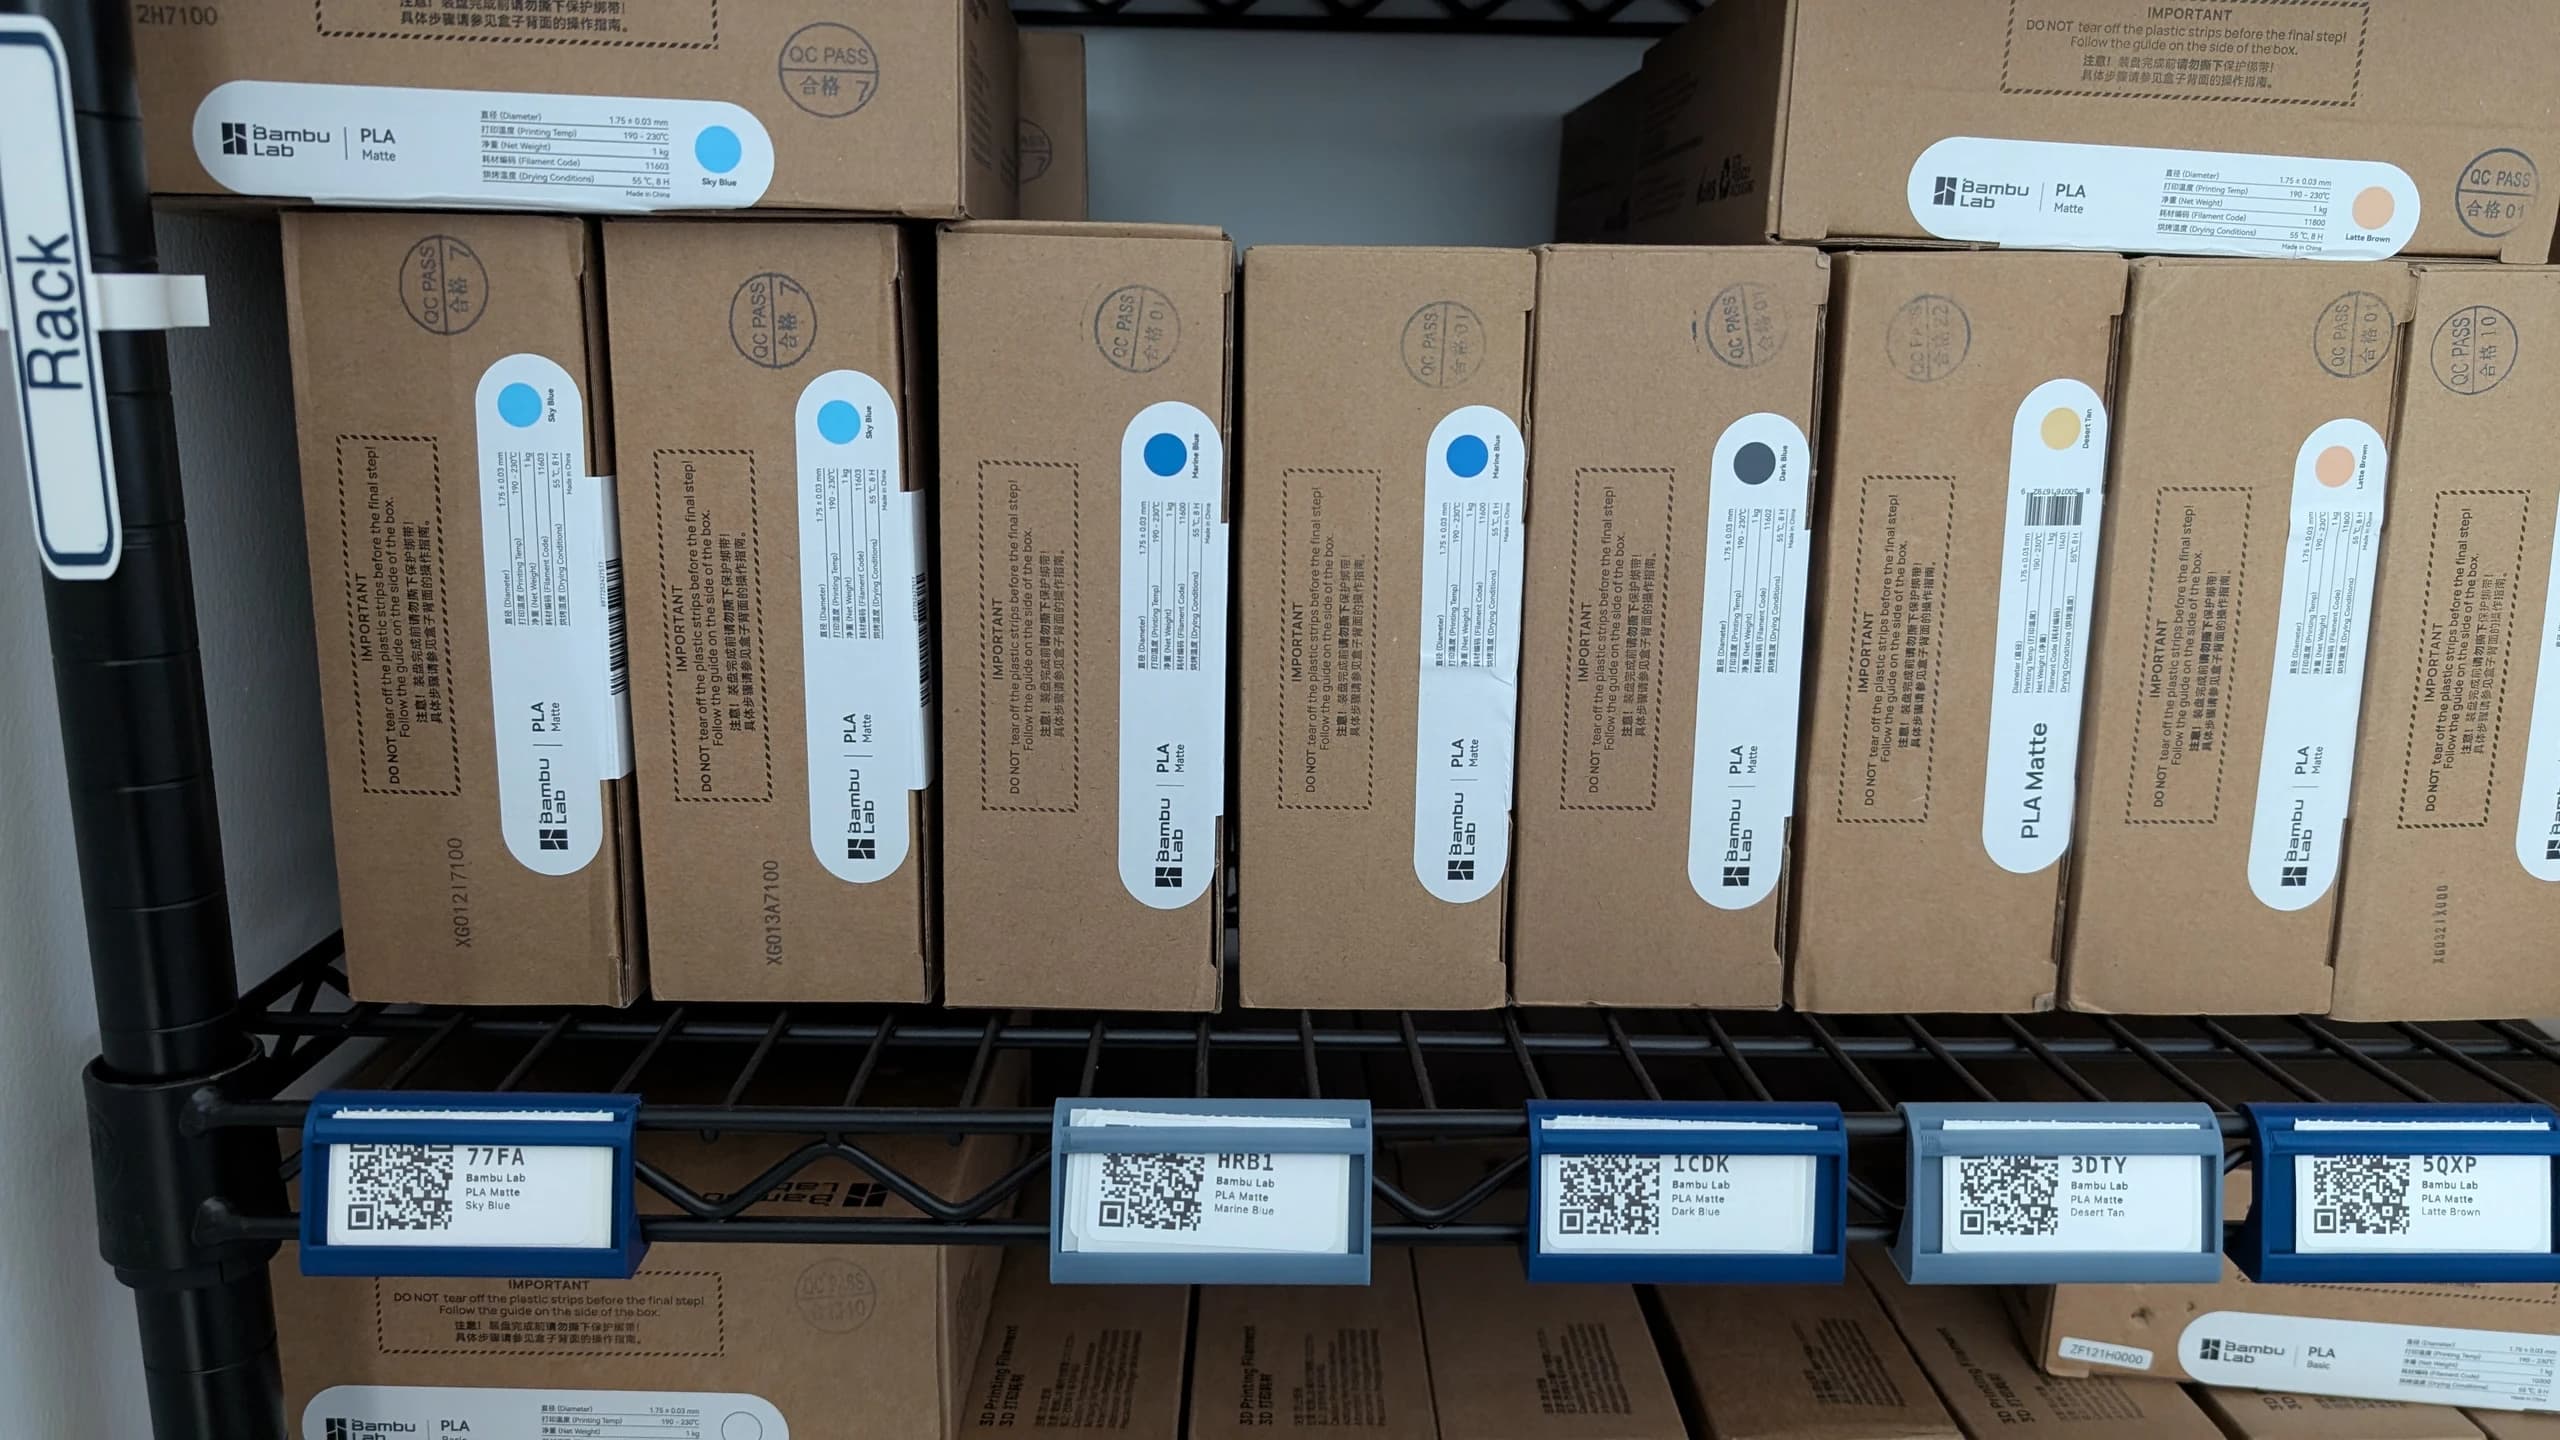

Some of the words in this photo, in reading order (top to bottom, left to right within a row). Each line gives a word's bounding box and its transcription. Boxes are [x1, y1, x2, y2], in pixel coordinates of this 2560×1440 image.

[2147, 6, 2232, 21] IMPORTANT
[788, 46, 818, 63] QC
[823, 46, 870, 65] PASS
[799, 75, 840, 96] 合格
[855, 80, 875, 104] 7
[252, 123, 330, 143] Bambu
[360, 127, 396, 144] PLA
[253, 142, 294, 157] Lab
[362, 149, 396, 162] Matte
[701, 177, 717, 188] Sky
[718, 178, 737, 186] Blue
[1961, 178, 2029, 196] Bambu
[2055, 183, 2086, 198] PLA
[1959, 194, 1995, 208] Lab
[2053, 202, 2084, 214] Matte
[2345, 233, 2365, 241] Latte
[2366, 234, 2390, 243] Brown
[449, 244, 470, 261] 7
[418, 245, 437, 291] PASS
[445, 277, 469, 315] 合格
[16, 234, 84, 389] Rack
[420, 297, 439, 326] QC
[2451, 317, 2470, 357] PASS
[2480, 316, 2496, 336] 10
[2478, 345, 2496, 377] 合格
[2450, 363, 2469, 386] QC
[546, 387, 555, 405] Blue
[547, 407, 557, 422] Sky
[864, 405, 872, 423] Blue
[2084, 408, 2092, 422] Tan
[865, 424, 874, 439] Sky
[1191, 432, 1199, 450] Blue
[2082, 424, 2091, 448] Desert
[535, 451, 546, 476] 11603
[1780, 444, 1788, 461] Blue
[2359, 443, 2368, 467] Brown
[1191, 453, 1199, 478] Marine
[1492, 454, 1500, 478] Marine
[1779, 463, 1787, 481] Dark
[2356, 469, 2365, 489] Latte
[1008, 478, 1022, 511] step!
[1008, 512, 1020, 539] final
[1762, 507, 1773, 531] 11602
[1008, 540, 1020, 562] the
[1022, 526, 1032, 553] box.
[1735, 535, 1745, 549] 190
[1022, 554, 1032, 575] the
[1008, 562, 1020, 604] before
[1022, 575, 1032, 589] of
[1022, 589, 1032, 618] side
[1731, 589, 1743, 613] Temp)
[355, 571, 373, 661] IMPORTANT
[671, 583, 688, 671] IMPORTANT
[1008, 604, 1022, 639] strips
[1730, 614, 1742, 642] (Printing
[991, 597, 1004, 679] IMPORTANT
[1022, 618, 1032, 639] the
[1577, 600, 1592, 681] IMPORTANT
[1022, 639, 1032, 657] on
[1291, 601, 1303, 682] IMPORTANT
[1857, 610, 1874, 692] IMPORTANT
[1008, 640, 1022, 681] plastic
[2149, 618, 2168, 697] IMPORTANT
[2423, 622, 2443, 702] IMPORTANT
[1022, 657, 1034, 691] guide
[1008, 682, 1020, 702] the
[1022, 692, 1032, 713] the
[530, 701, 545, 731] PLA
[550, 701, 560, 731] Matte
[1008, 702, 1020, 721] off
[842, 713, 856, 742] PLA
[861, 713, 872, 742] Matte
[1008, 721, 1020, 745] tear
[1022, 713, 1032, 751] Follow
[1008, 749, 1020, 775] NOT
[1156, 742, 1170, 772] PLA
[1174, 743, 1185, 772] Matte
[1450, 737, 1464, 767] PLA
[1468, 738, 1479, 766] Matte
[1729, 744, 1743, 774] PLA
[1746, 745, 1758, 773] Matte
[2025, 722, 2047, 789] Matte
[2294, 745, 2310, 774] PLA
[2311, 745, 2323, 773] Matte
[538, 757, 553, 823] Bambu
[1008, 776, 1020, 794] DO
[553, 789, 567, 823] Lab
[847, 768, 861, 833] Bambu
[862, 800, 875, 833] Lab
[1448, 792, 1464, 855] Bambu
[2020, 796, 2041, 838] PLA
[1155, 797, 1170, 861] Bambu
[1463, 822, 1476, 855] Lab
[1724, 798, 1741, 861] Bambu
[2283, 798, 2304, 861] Bambu
[1171, 828, 1183, 862] Lab
[1739, 828, 1752, 861] Lab
[2298, 828, 2312, 861] Lab
[762, 860, 783, 966] XG013A7100
[467, 1147, 524, 1165] 77FA
[1216, 1153, 1275, 1171] HRB1
[1672, 1154, 1730, 1172] 1CDK
[2072, 1155, 2127, 1173] 3DTY
[2423, 1155, 2476, 1176] 5QXP
[466, 1173, 502, 1182] Bambu
[506, 1173, 525, 1182] Lab
[1216, 1176, 1252, 1186] Bambu
[1255, 1178, 1274, 1188] Lab
[1672, 1180, 1707, 1189] Bambu
[1711, 1180, 1730, 1189] Lab
[2071, 1181, 2106, 1190] Bambu
[2110, 1181, 2128, 1190] Lab
[2422, 1180, 2456, 1189] Bambu
[2460, 1180, 2478, 1189] Lab
[465, 1187, 486, 1196] PLA
[490, 1187, 520, 1196] Matte
[1215, 1190, 1235, 1200] PLA
[1239, 1191, 1268, 1202] Matte
[1671, 1193, 1692, 1202] PLA
[1695, 1194, 1724, 1203] Matte
[2070, 1194, 2090, 1203] PLA
[2094, 1195, 2123, 1204] Matte
[2421, 1194, 2441, 1203] PLA
[2444, 1194, 2473, 1203] Matte
[465, 1200, 484, 1211] Sky
[487, 1200, 510, 1209] Blue
[1214, 1203, 1248, 1213] Marine
[1252, 1205, 1274, 1215] Blue
[1671, 1206, 1695, 1215] Dark
[1698, 1207, 1720, 1216] Blue
[2070, 1207, 2103, 1216] Desert
[2107, 1208, 2124, 1216] Tan
[2421, 1206, 2446, 1215] Latte
[2449, 1207, 2480, 1216] Brown
[2224, 1351, 2255, 1363] Lab
[2225, 1340, 2285, 1355] Bambu
[2309, 1346, 2335, 1358] PLA
[2308, 1359, 2330, 1370] Basic
[351, 1418, 415, 1434] Bambu
[440, 1420, 470, 1431] PLA
